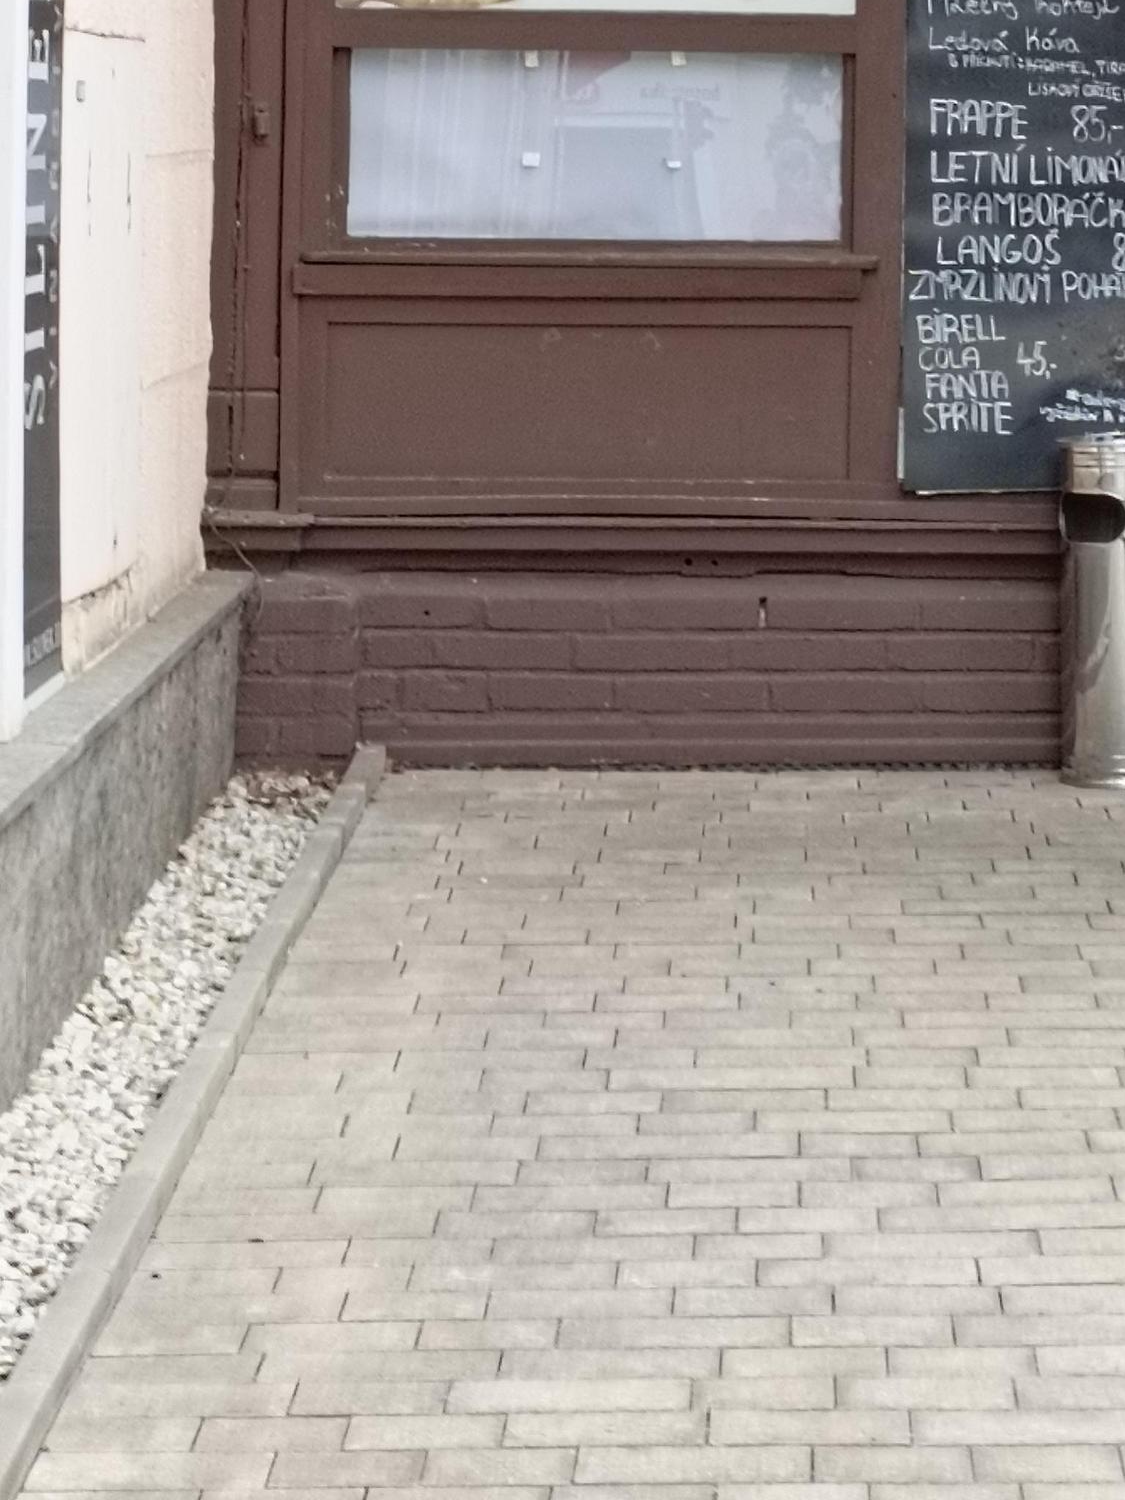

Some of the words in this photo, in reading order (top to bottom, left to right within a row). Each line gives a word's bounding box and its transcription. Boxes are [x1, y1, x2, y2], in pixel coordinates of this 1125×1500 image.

[930, 99, 1028, 139] FRAPPE
[1070, 105, 1124, 144] 85,-
[930, 143, 1026, 185] LETNÍ
[936, 228, 1061, 265] LANGOŠ
[919, 346, 981, 371] COLA
[1017, 341, 1057, 380] 45,-
[926, 372, 1010, 400] FANTA
[923, 399, 1014, 435] SPRITE
